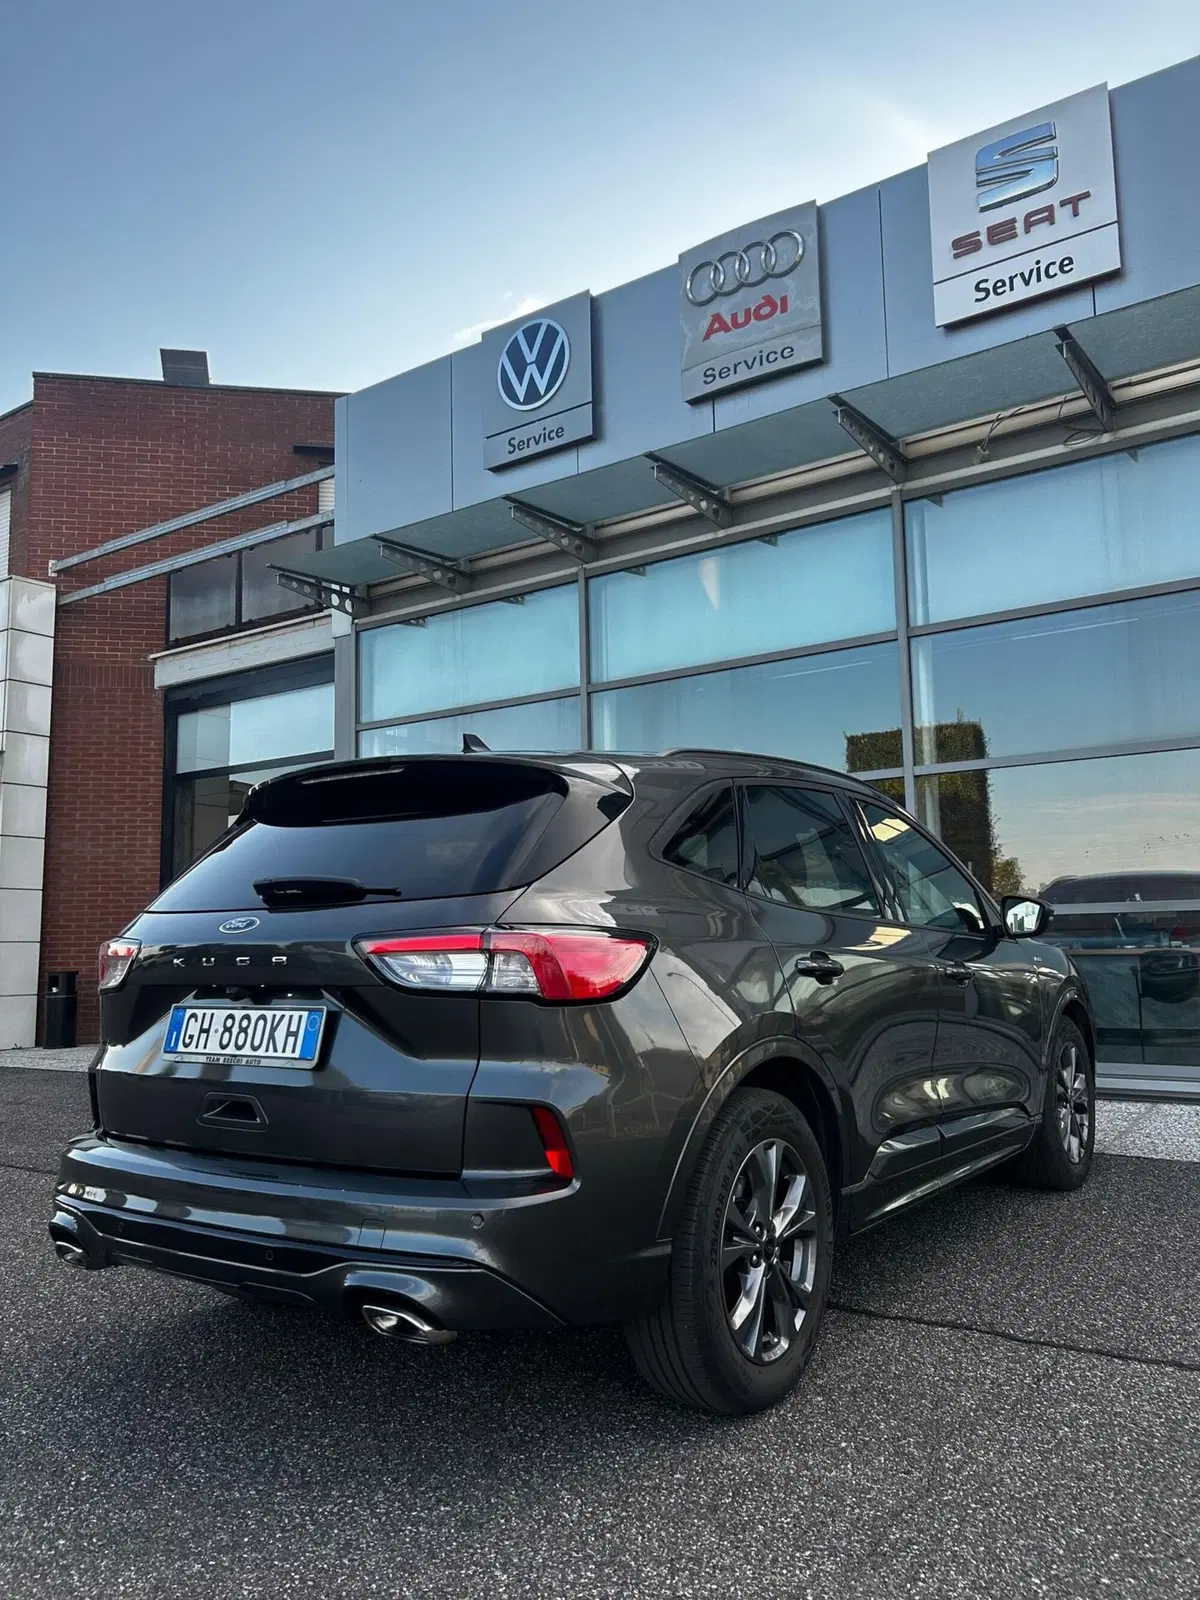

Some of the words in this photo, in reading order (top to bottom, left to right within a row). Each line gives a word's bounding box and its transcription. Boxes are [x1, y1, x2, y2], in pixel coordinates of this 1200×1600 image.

[951, 190, 1092, 260] SEAT
[973, 256, 1075, 303] Service
[702, 294, 789, 342] Audi
[702, 345, 795, 385] Service
[507, 426, 565, 455] Service
[172, 956, 288, 968] KUGA
